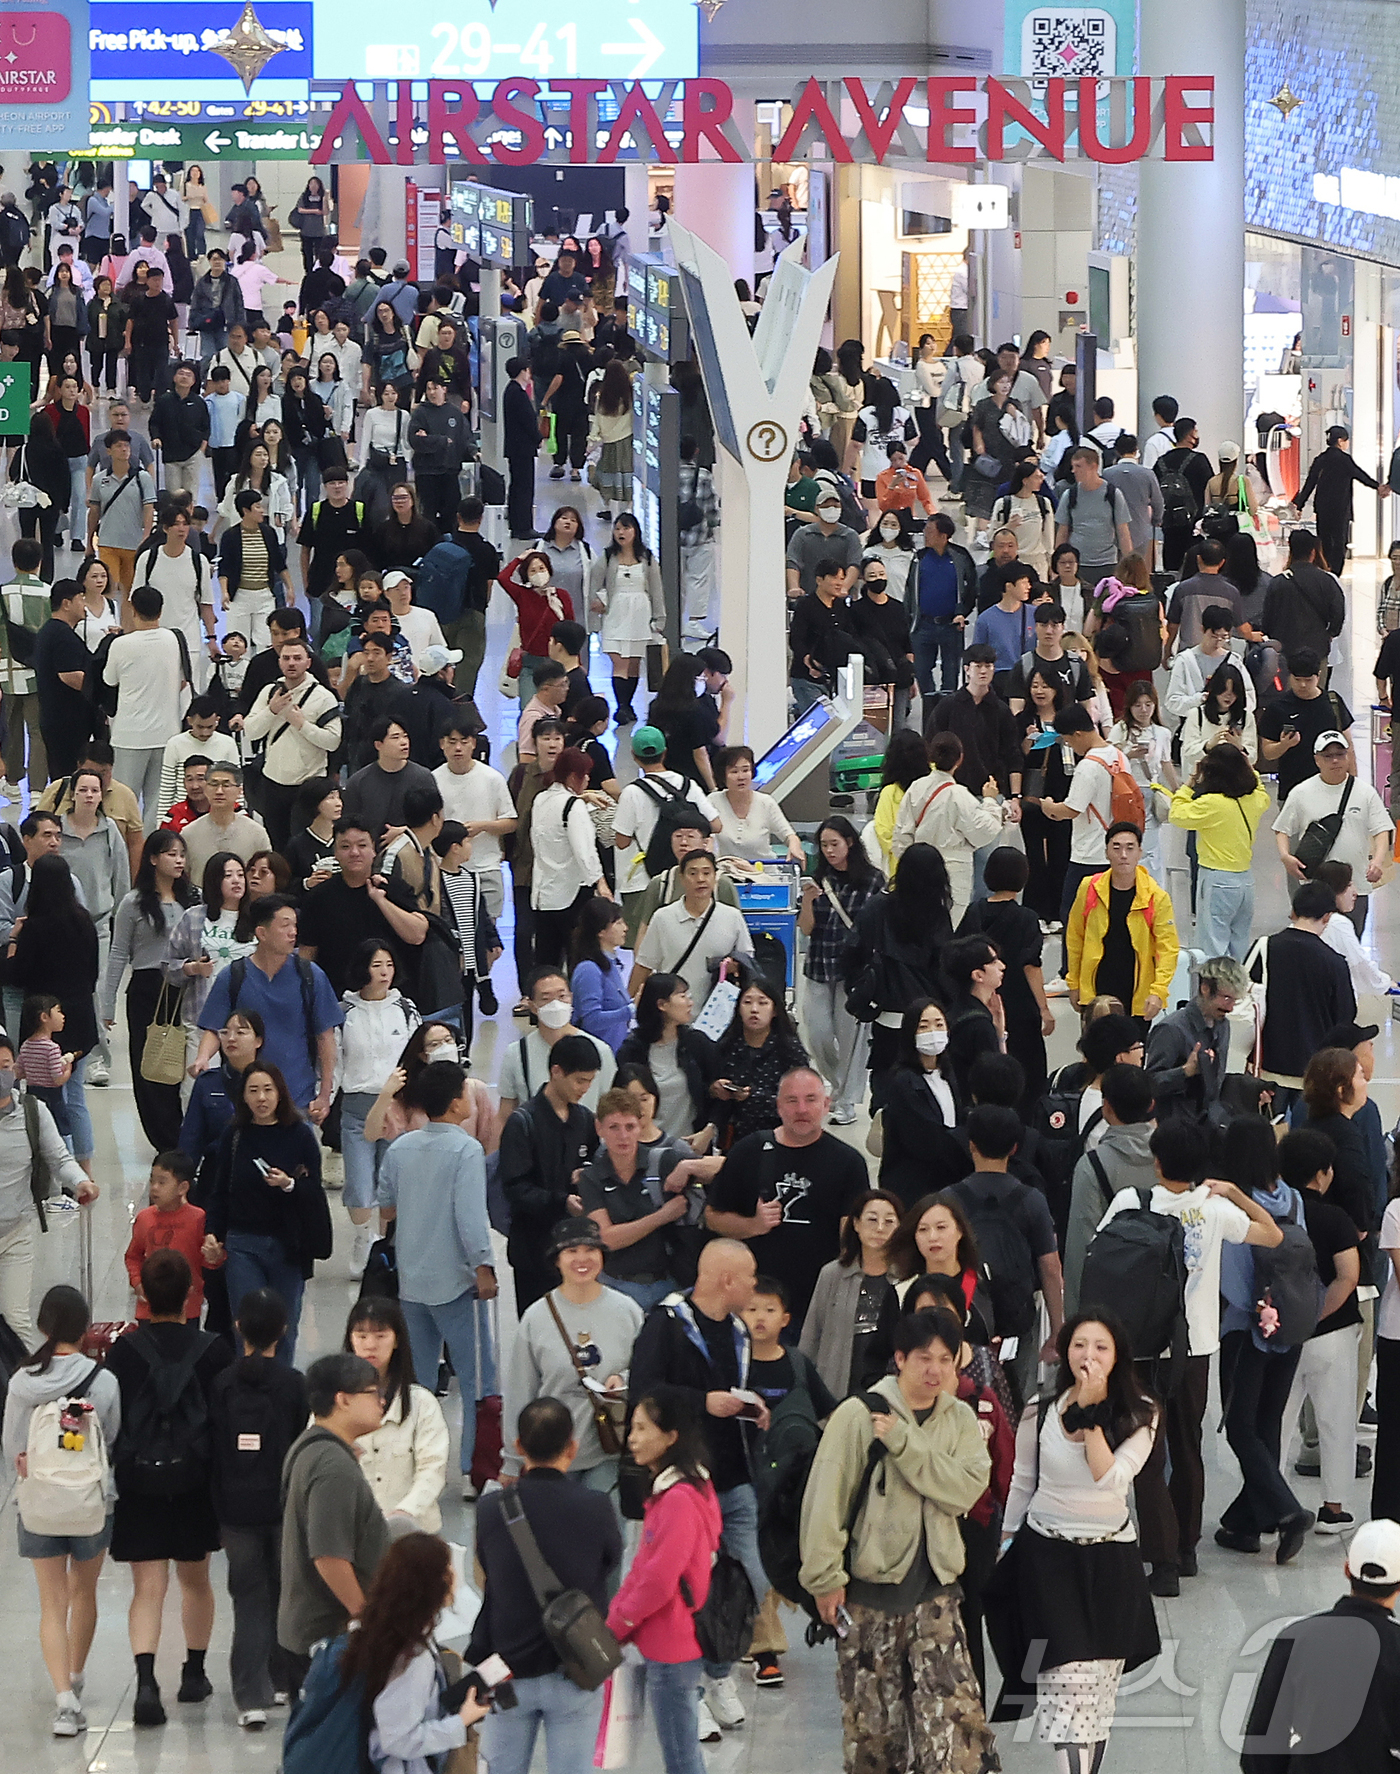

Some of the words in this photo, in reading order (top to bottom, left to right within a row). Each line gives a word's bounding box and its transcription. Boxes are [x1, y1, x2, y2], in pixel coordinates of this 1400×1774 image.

[89, 29, 127, 50] Free
[431, 22, 578, 75] 29-41
[308, 77, 743, 167] AIRSTAR
[771, 75, 1214, 167] AVENUE
